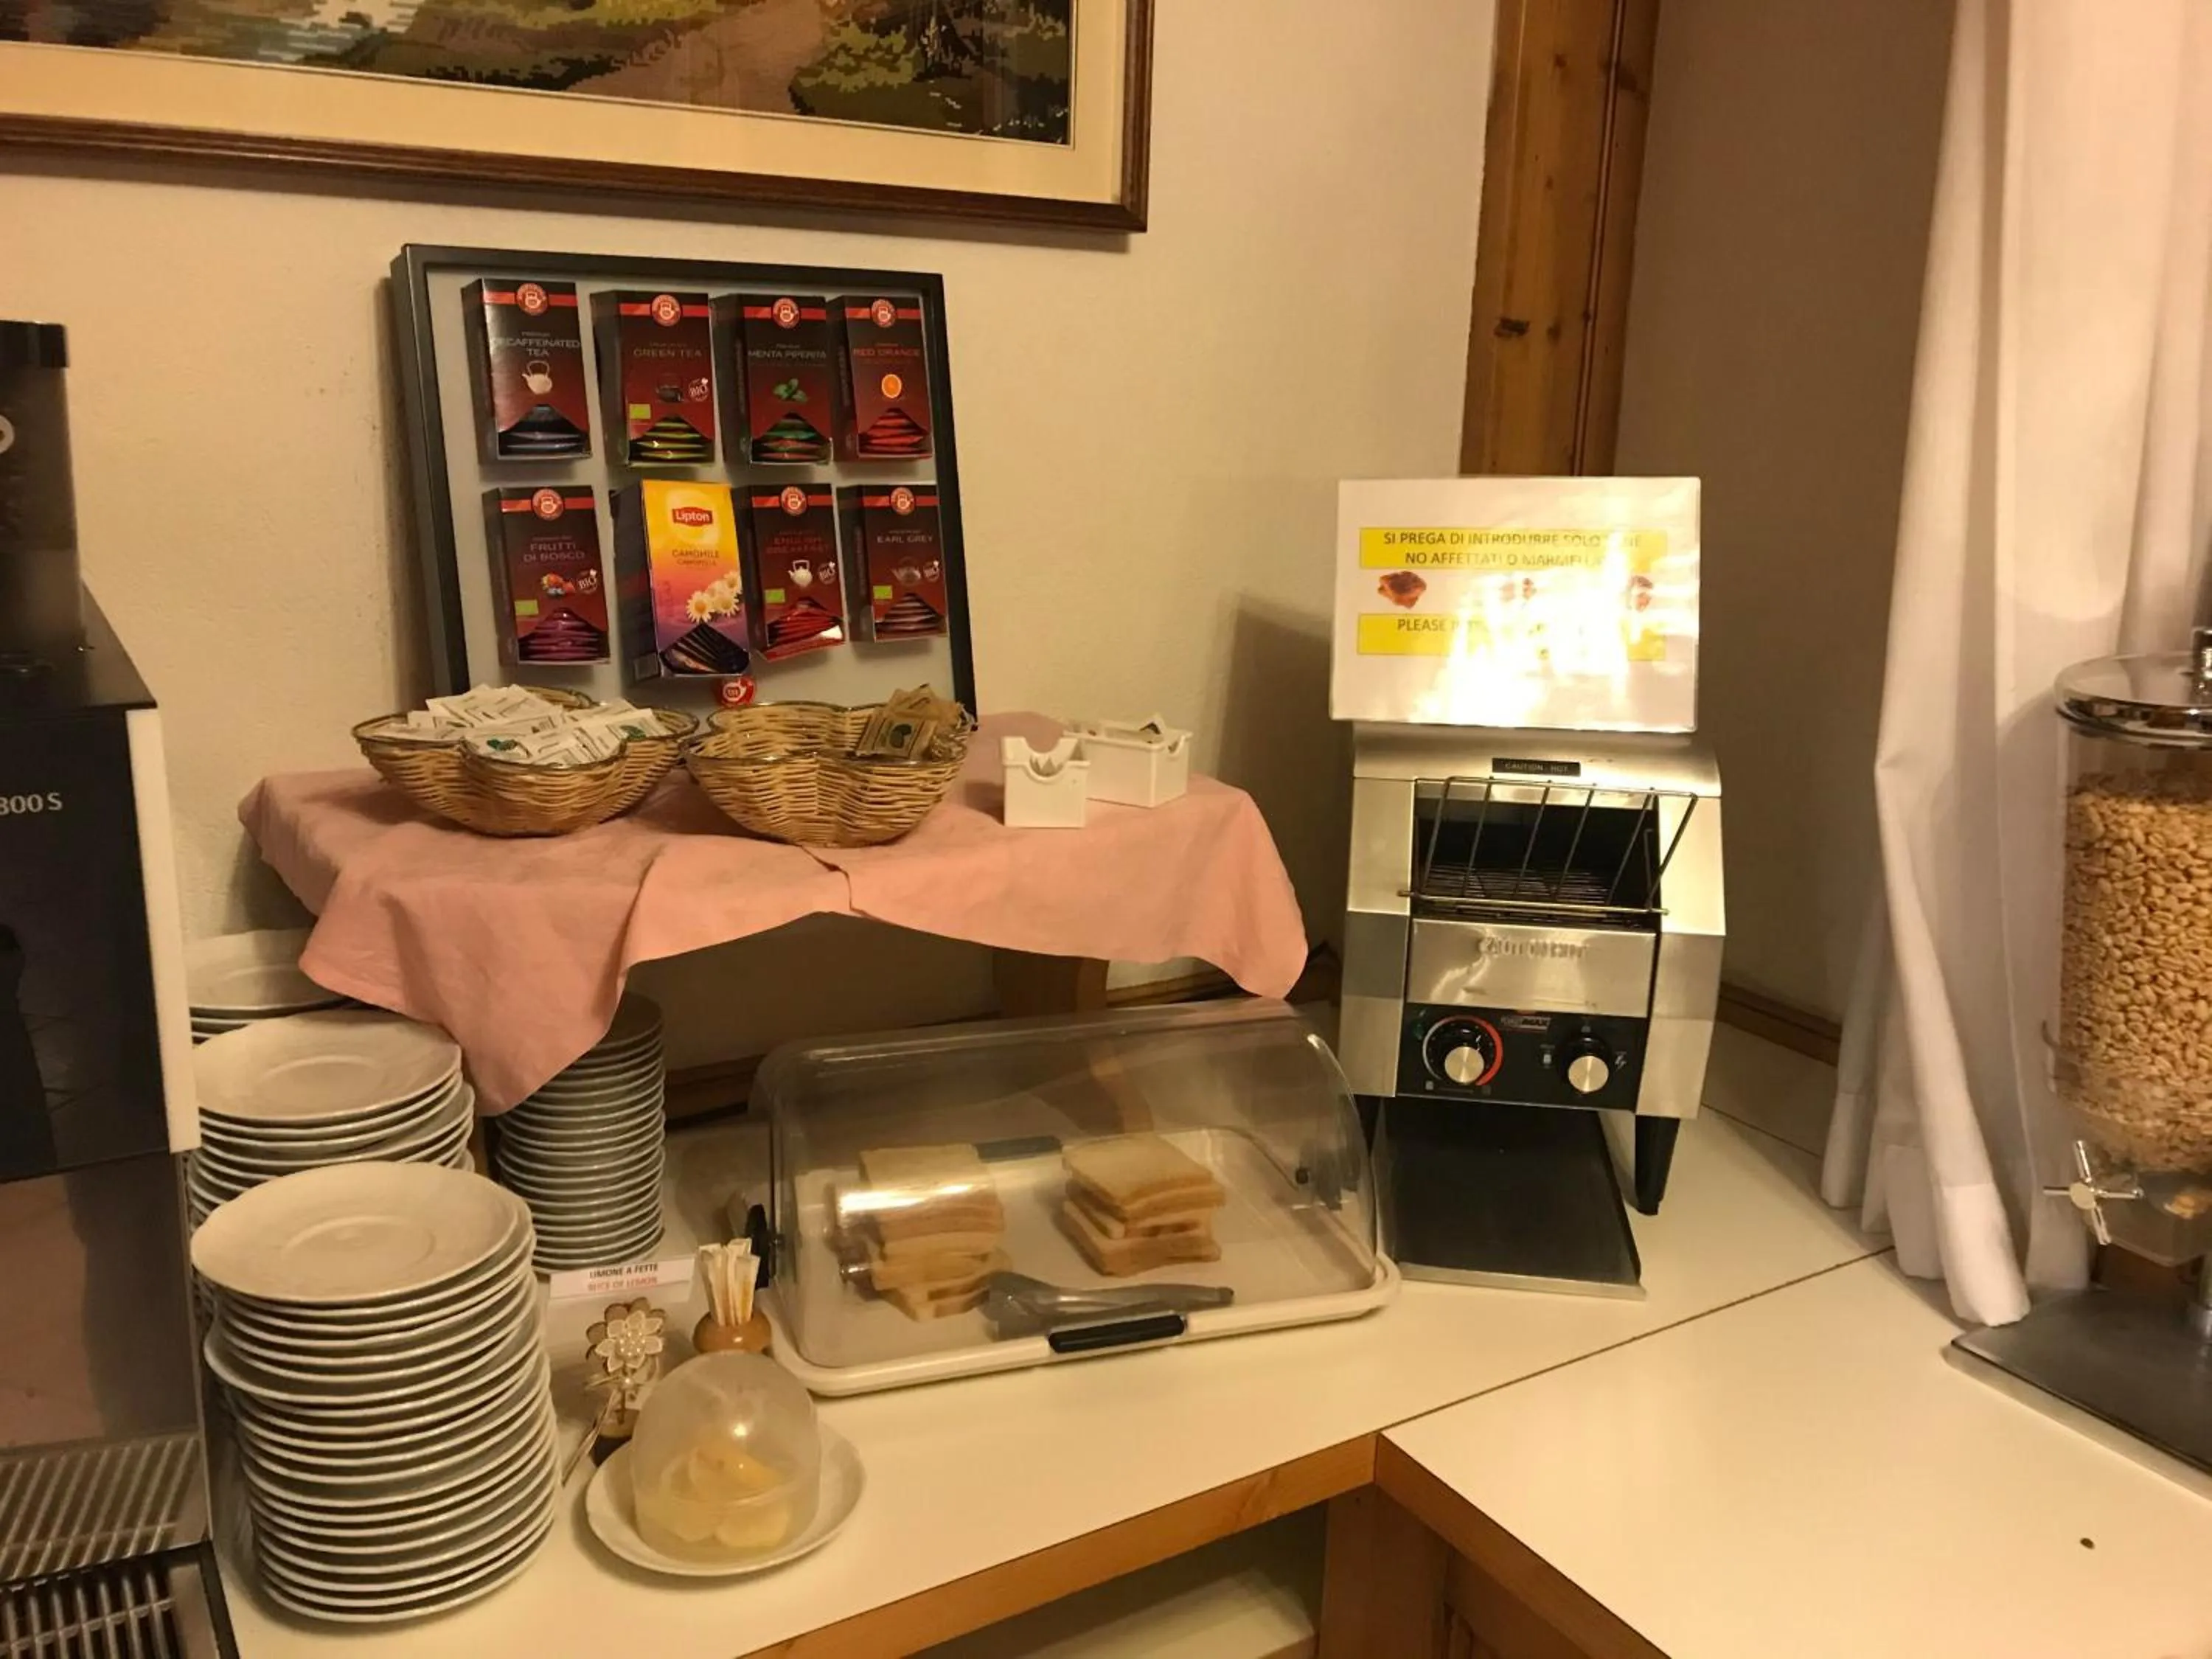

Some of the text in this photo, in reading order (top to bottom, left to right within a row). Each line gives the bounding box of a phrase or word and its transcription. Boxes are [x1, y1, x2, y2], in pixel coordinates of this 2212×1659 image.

[526, 348, 549, 357] TEA
[633, 347, 702, 358] GREEN TEA
[675, 511, 710, 523] Lipton
[877, 535, 933, 543] EARL GREY
[1383, 532, 1397, 545] SI
[1399, 532, 1446, 545] PREGA
[1450, 532, 1464, 545] DI
[1468, 533, 1559, 546] INTRODURRE
[529, 541, 577, 552] FRUTTI
[523, 552, 585, 563] DI BOSCO
[1405, 552, 1427, 565] NO
[1430, 552, 1502, 566] AFFETTATI
[578, 576, 597, 589] BIO
[1397, 618, 1447, 632] PLEASE
[47, 792, 63, 811] S
[589, 1267, 623, 1279] LIMONE
[635, 1262, 658, 1274] FETTE
